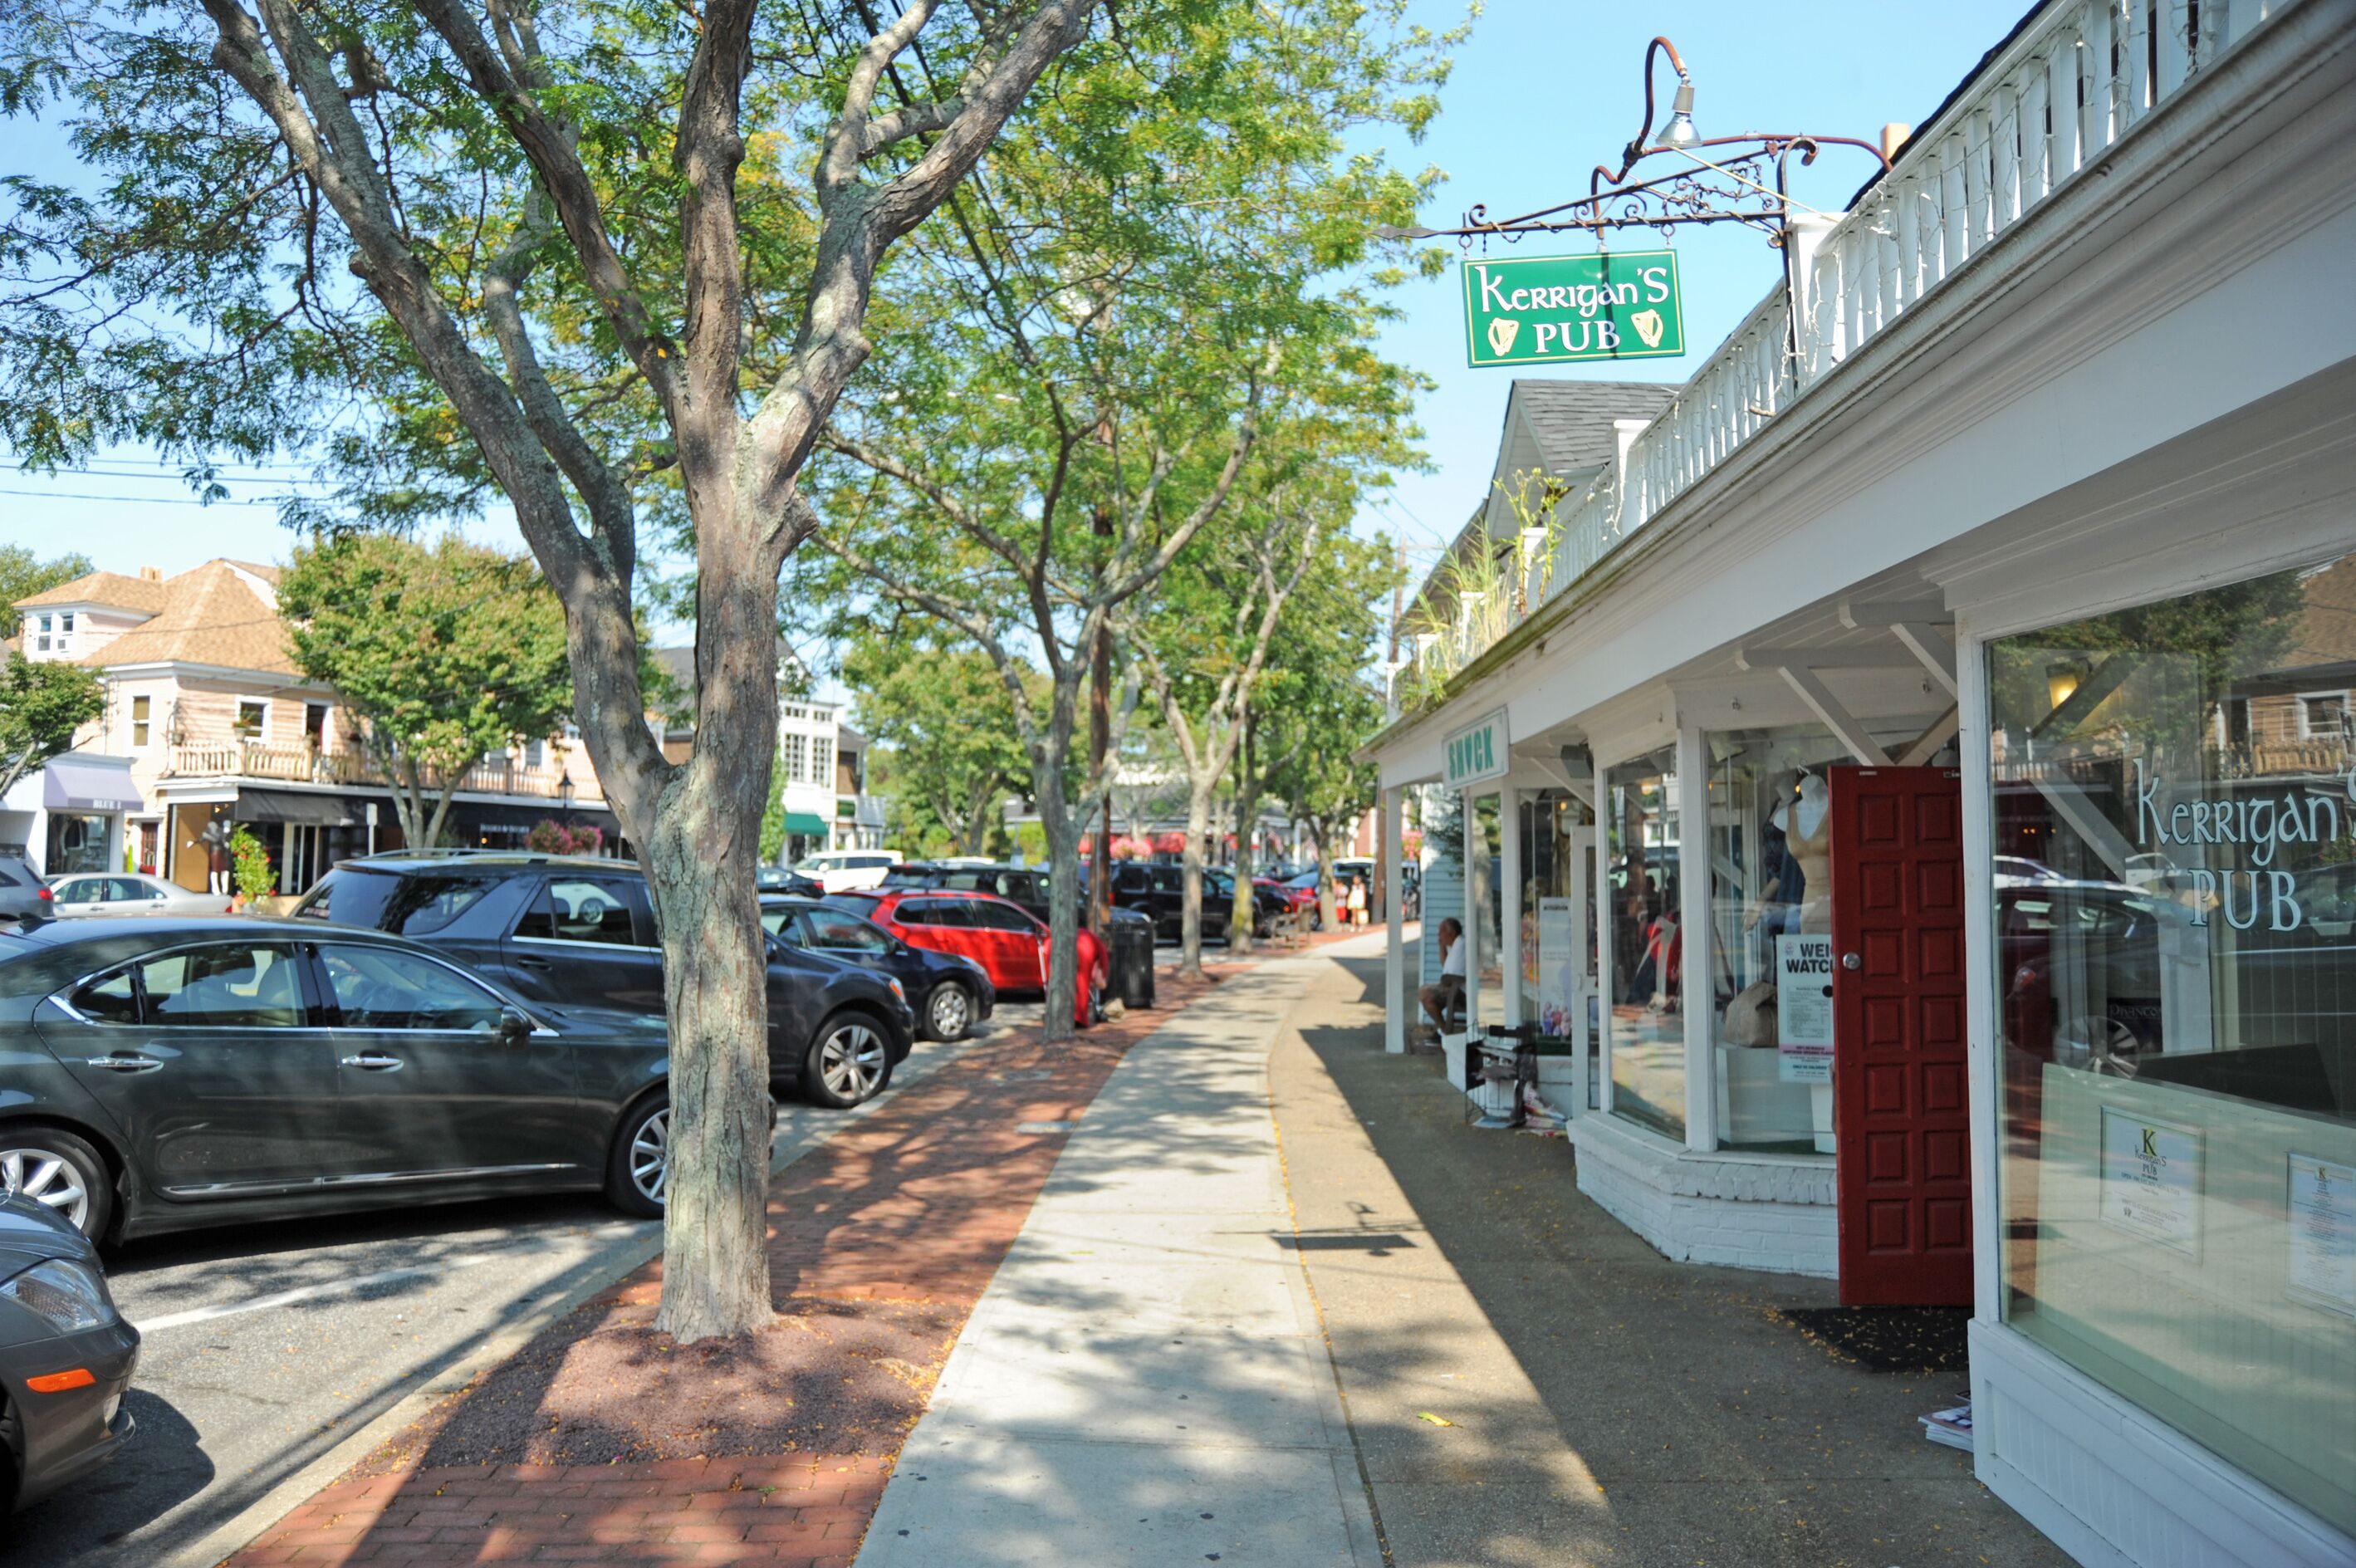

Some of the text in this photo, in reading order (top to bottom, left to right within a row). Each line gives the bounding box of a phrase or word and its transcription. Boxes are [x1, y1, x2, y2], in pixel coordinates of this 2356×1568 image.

[1532, 321, 1621, 353] PUB
[2188, 869, 2302, 932] PUB
[1800, 943, 1833, 958] WEI
[2142, 1128, 2158, 1156] K
[2143, 1163, 2158, 1176] PUB
